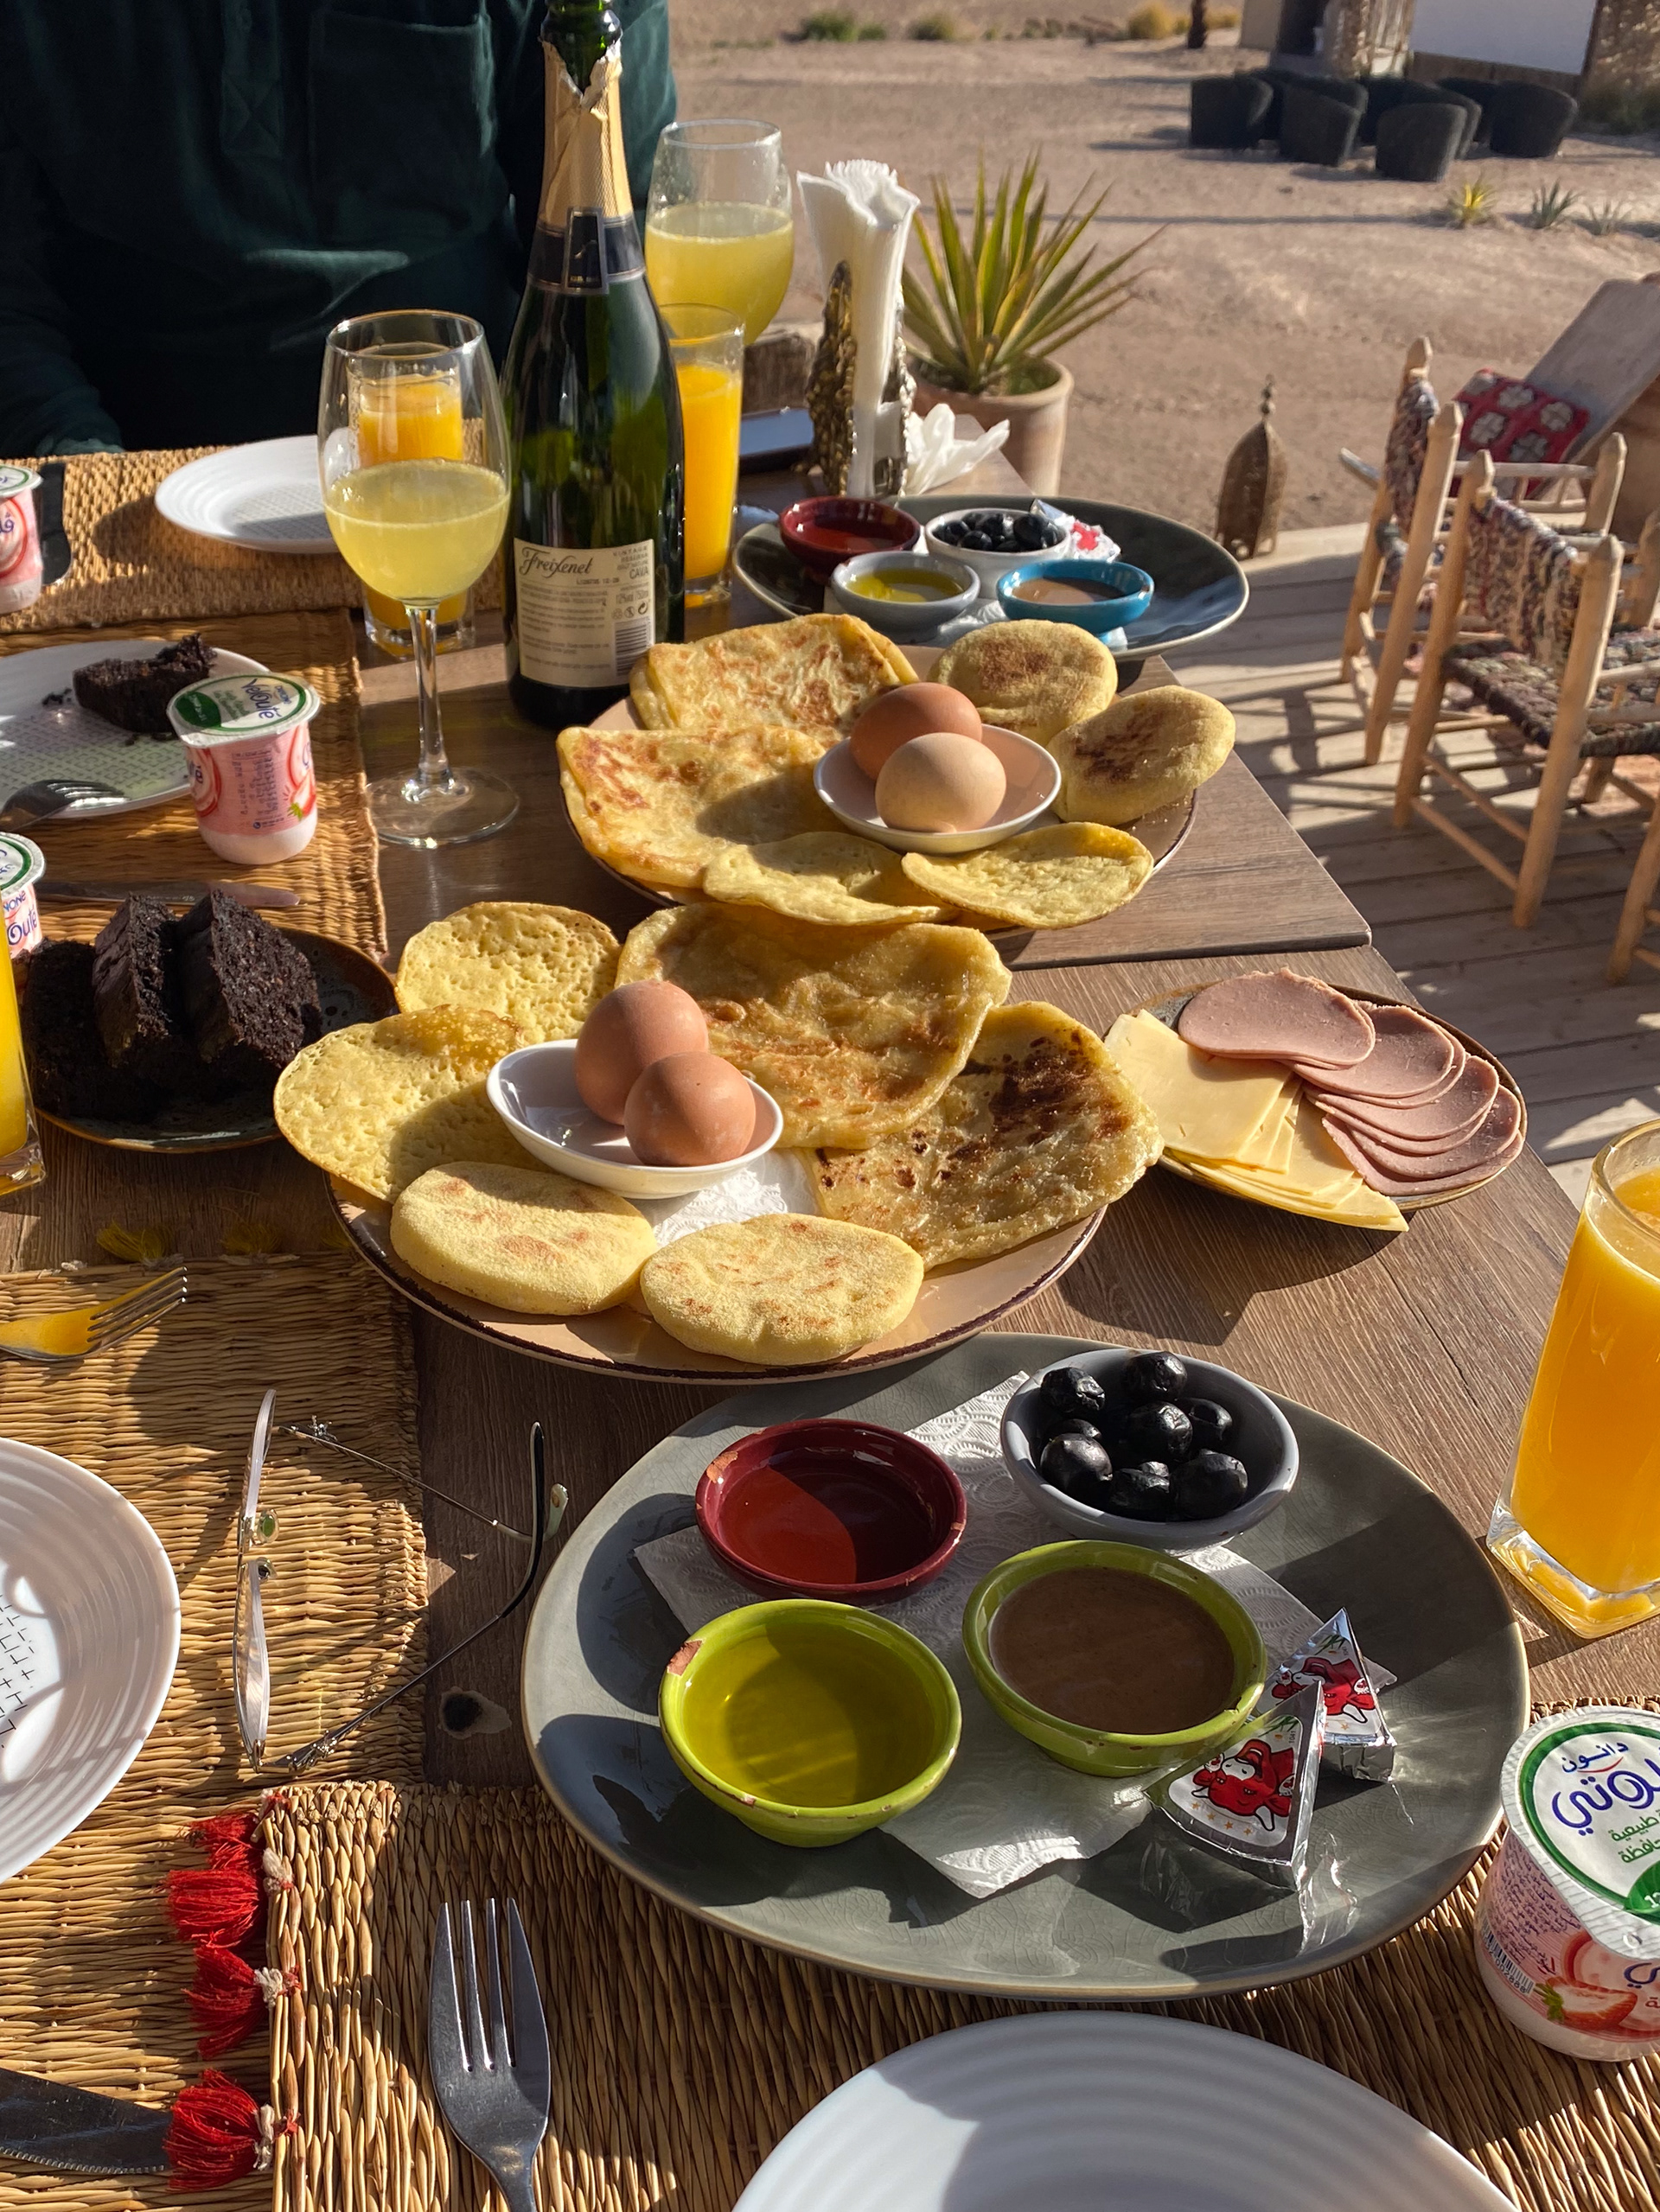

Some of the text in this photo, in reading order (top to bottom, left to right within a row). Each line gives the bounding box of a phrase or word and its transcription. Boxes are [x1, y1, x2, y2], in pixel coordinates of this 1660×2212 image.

[520, 546, 593, 578] Freixenet
[629, 566, 648, 580] CAVA
[1552, 1748, 1660, 1836] لوتي
[1608, 1816, 1659, 1841] طبيعية
